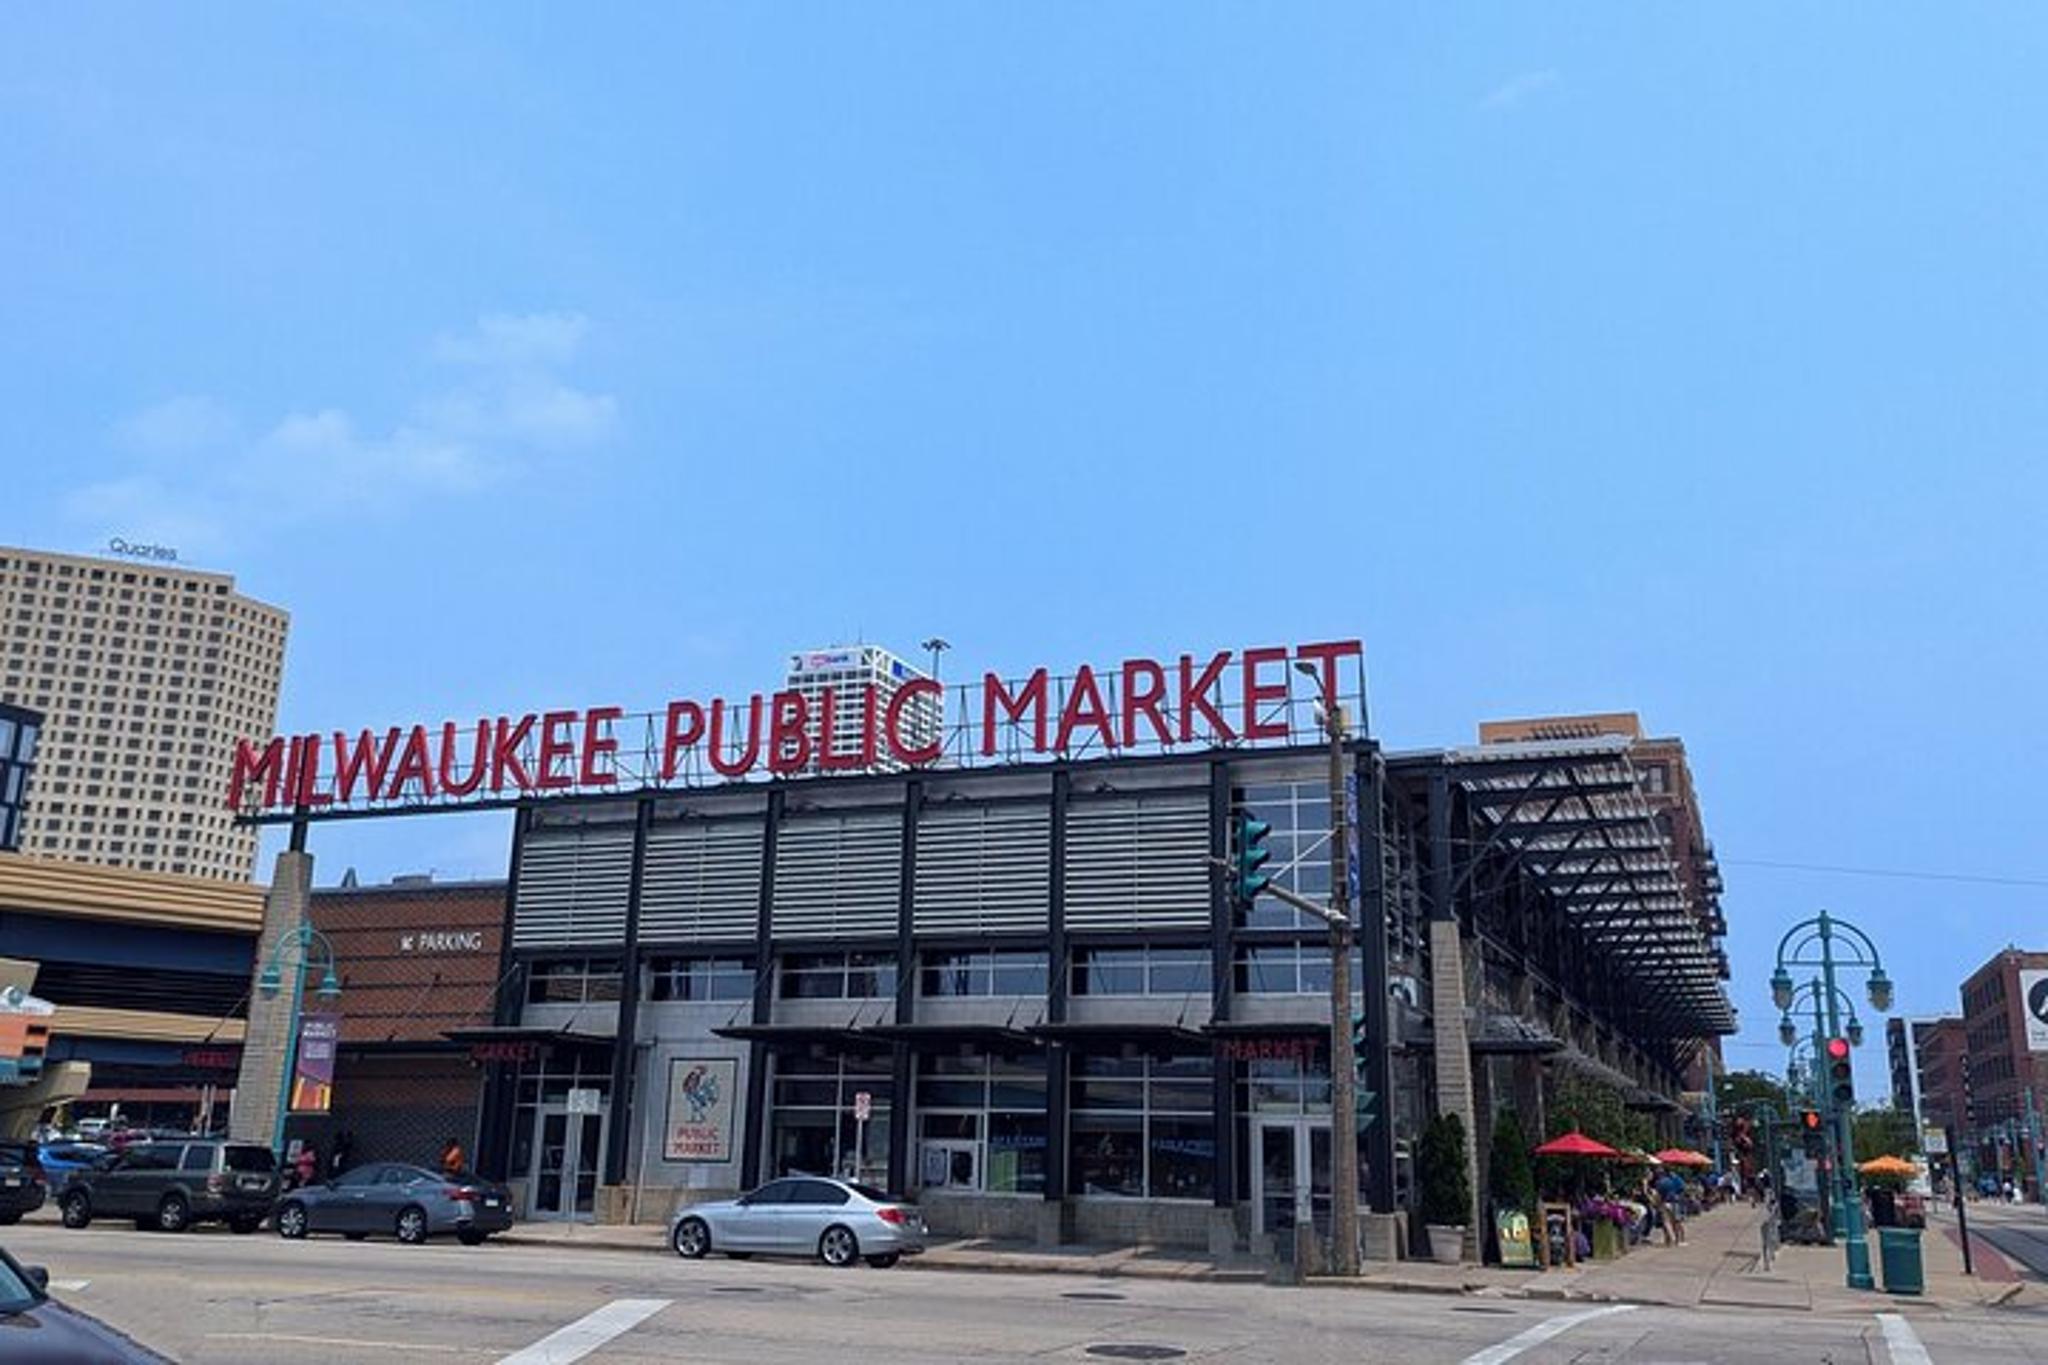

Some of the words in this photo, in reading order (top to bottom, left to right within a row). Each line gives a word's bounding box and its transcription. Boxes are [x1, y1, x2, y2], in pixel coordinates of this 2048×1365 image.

[229, 707, 623, 811] MILWAUKEE
[662, 678, 943, 780] PUBLIC
[981, 640, 1361, 756] MARKET
[420, 932, 482, 951] PARKING
[1217, 1038, 1321, 1062] MARKET
[677, 1127, 719, 1140] PUBLIC
[673, 1142, 721, 1155] MARKET
